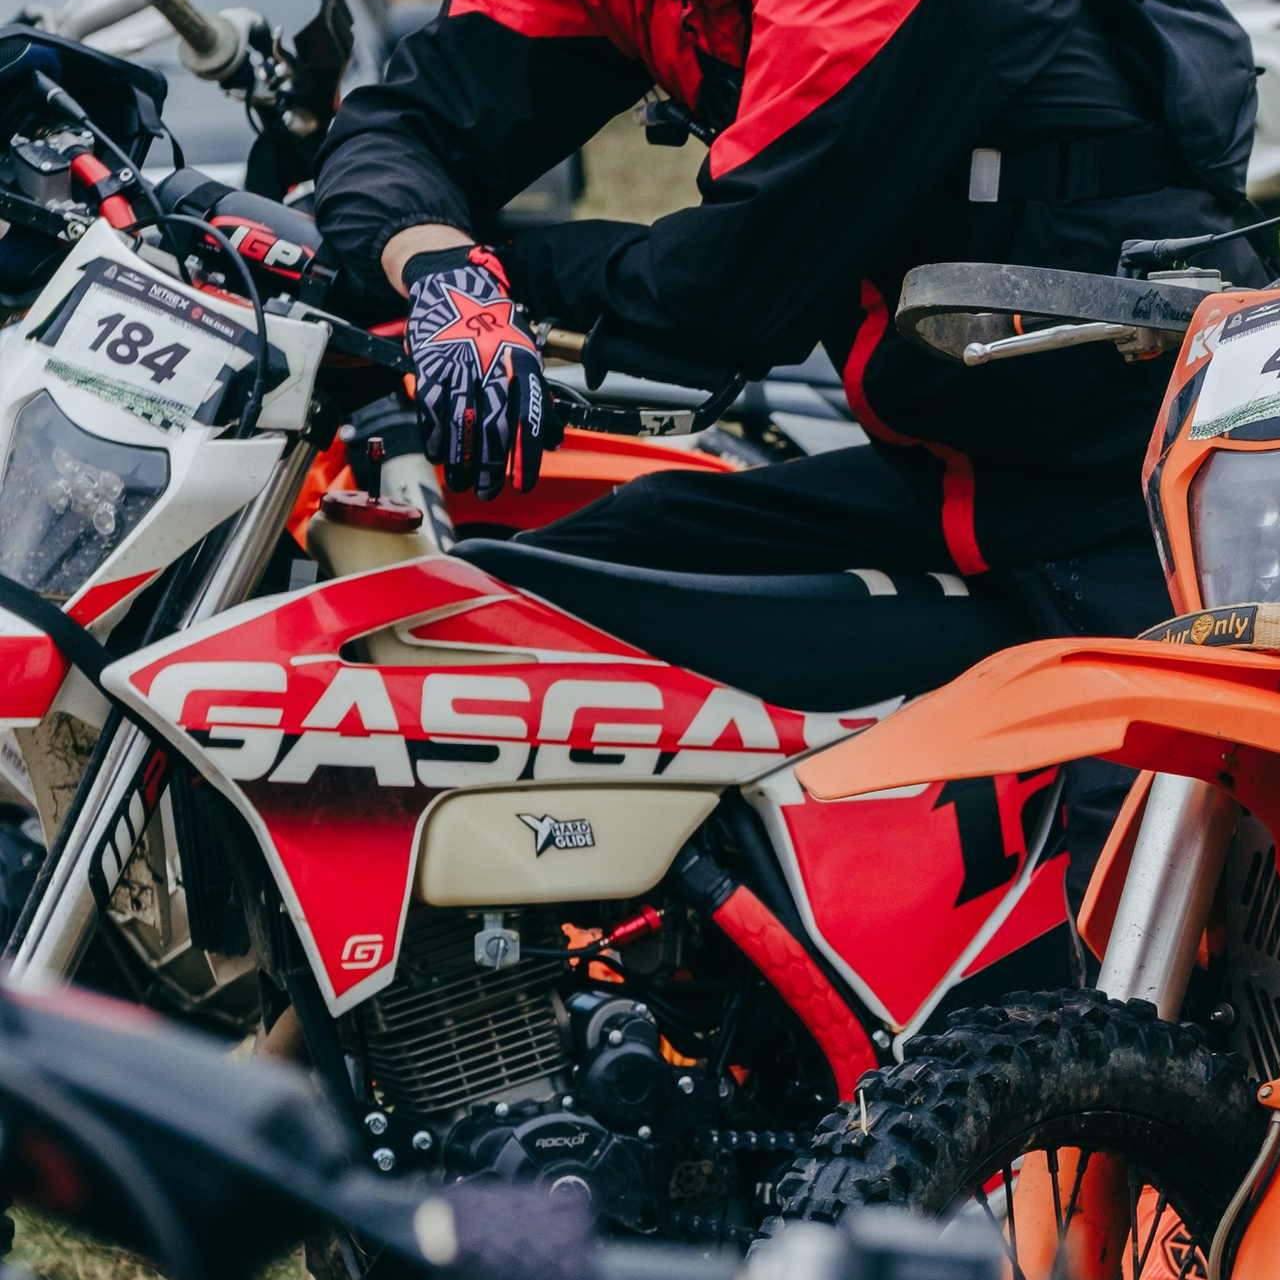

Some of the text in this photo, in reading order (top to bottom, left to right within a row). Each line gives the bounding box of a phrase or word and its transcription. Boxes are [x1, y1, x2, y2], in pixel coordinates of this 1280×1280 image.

[150, 283, 191, 310] NITREX
[89, 312, 191, 385] 184
[551, 822, 589, 836] HARD
[555, 834, 594, 848] GLIDE
